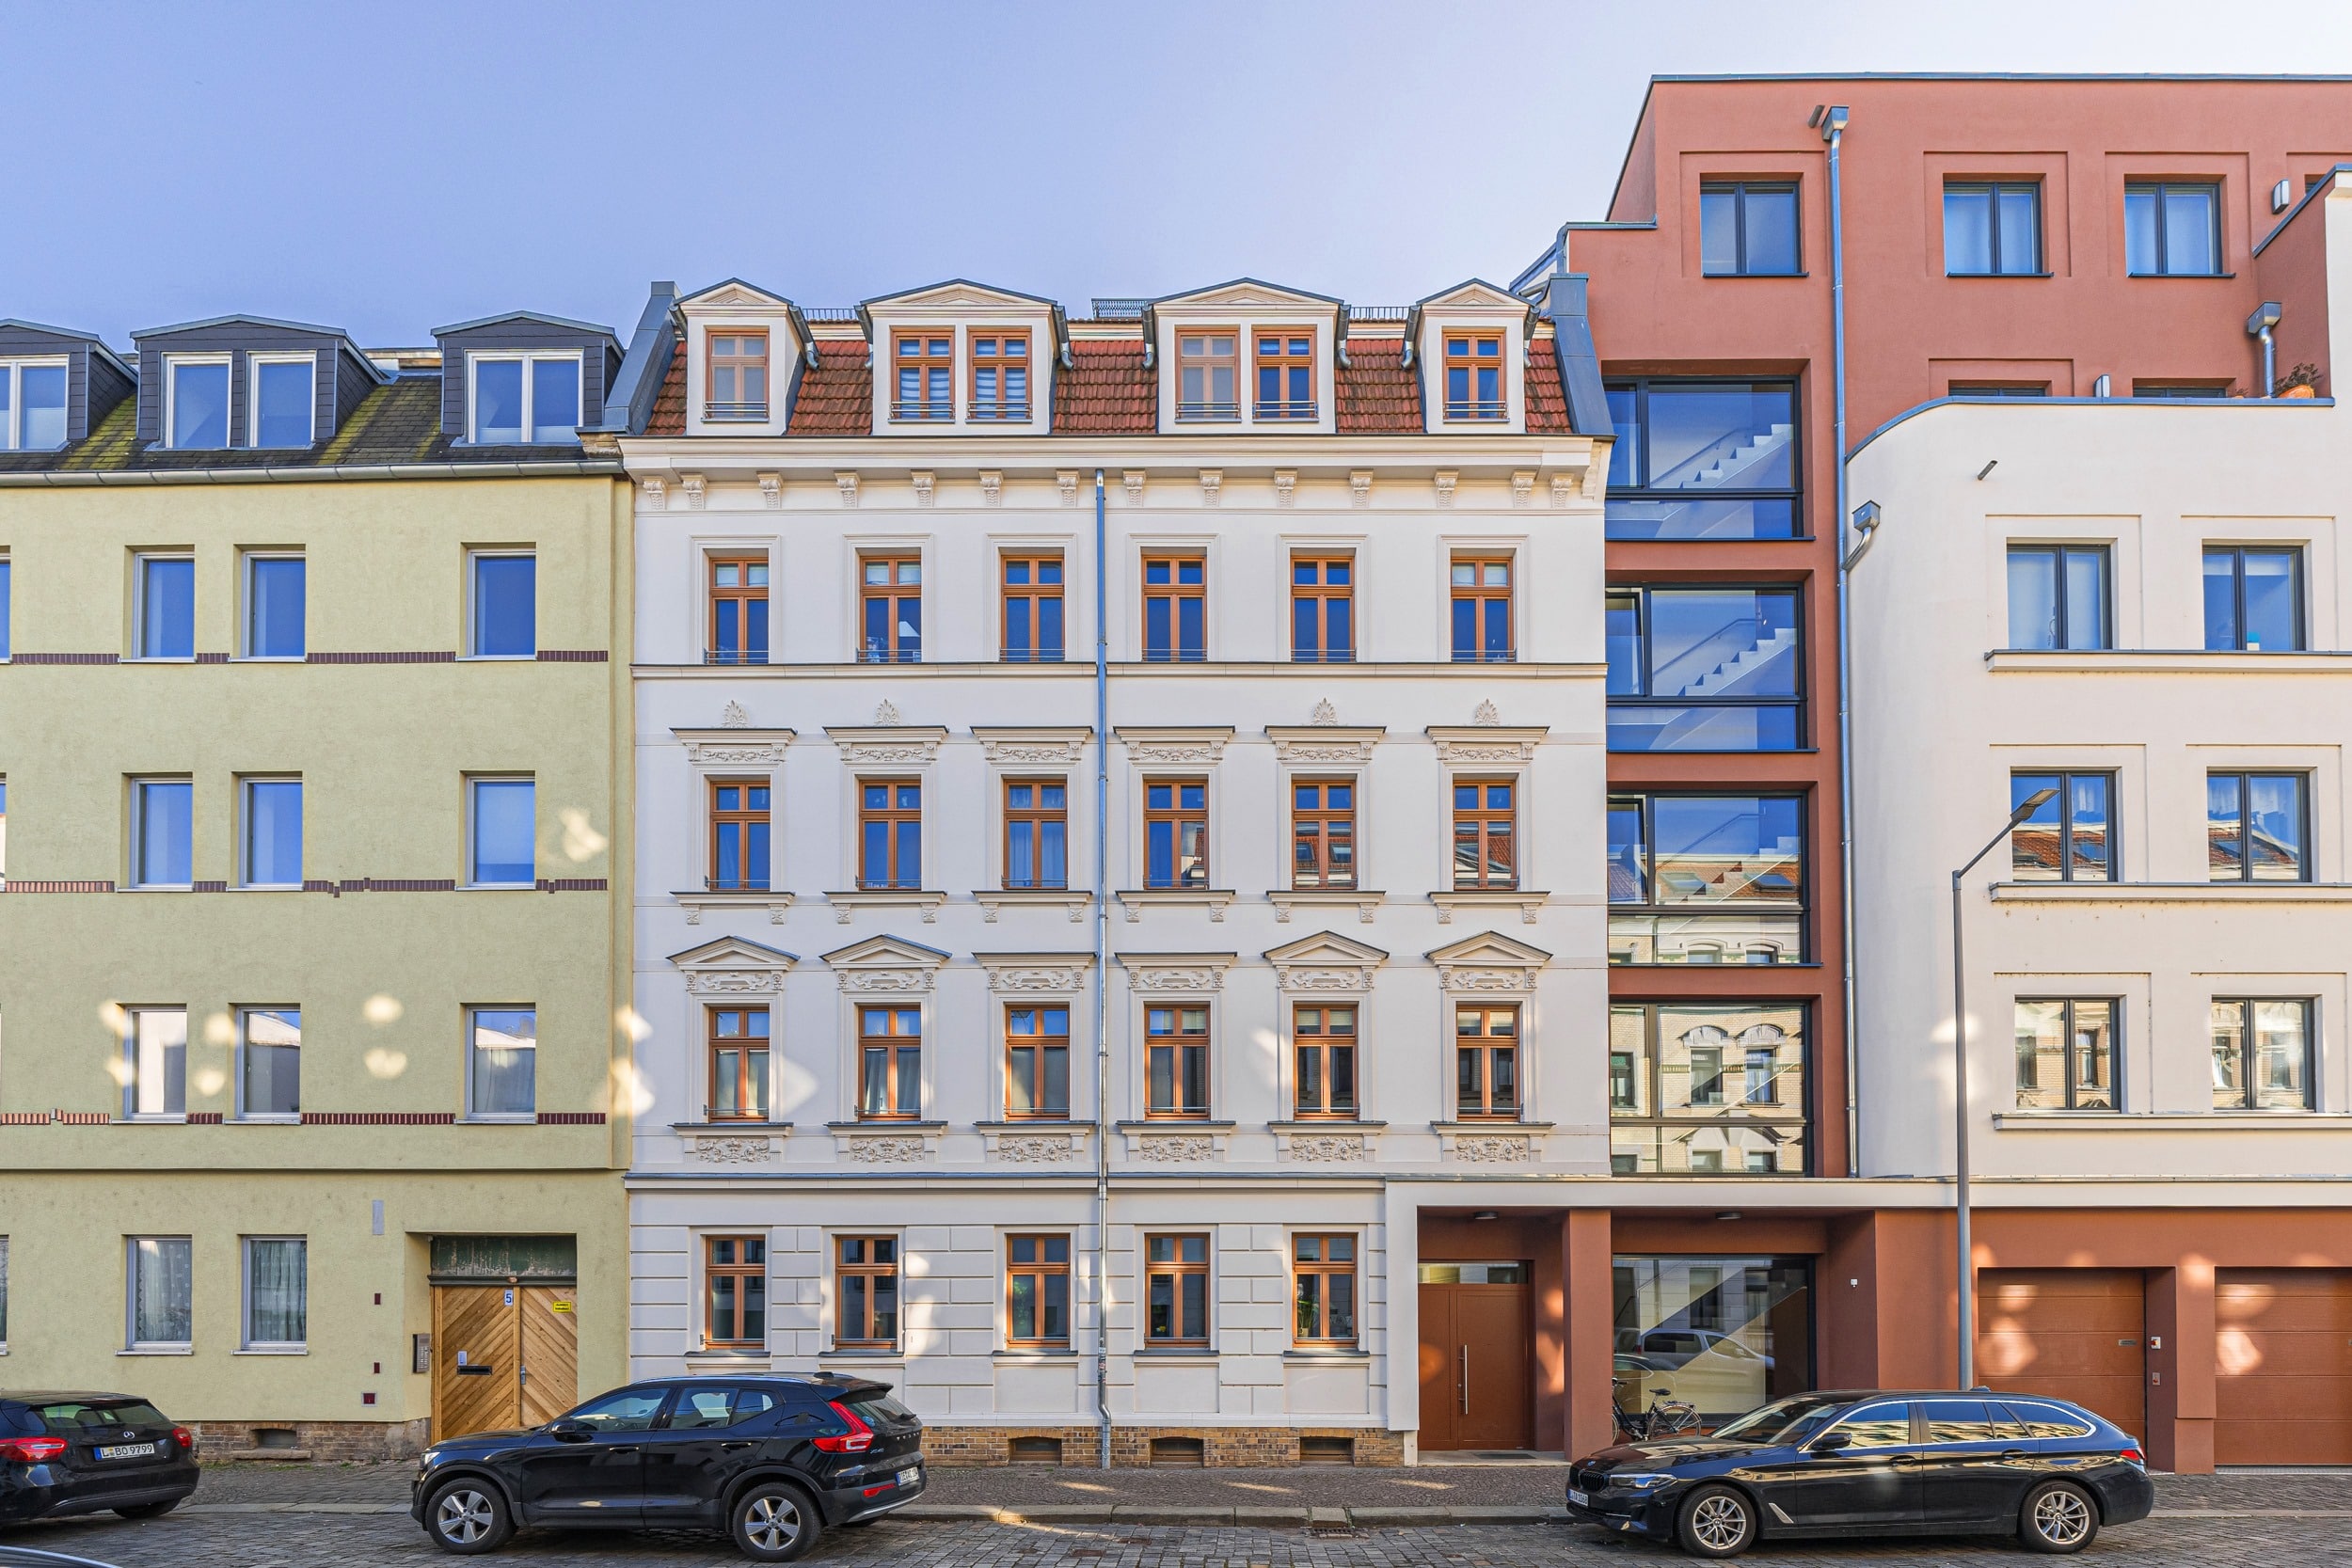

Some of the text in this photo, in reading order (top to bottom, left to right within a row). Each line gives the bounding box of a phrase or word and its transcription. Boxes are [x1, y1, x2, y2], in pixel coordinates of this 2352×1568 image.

[506, 1293, 512, 1304] 5
[102, 1444, 152, 1457] L BO 9799
